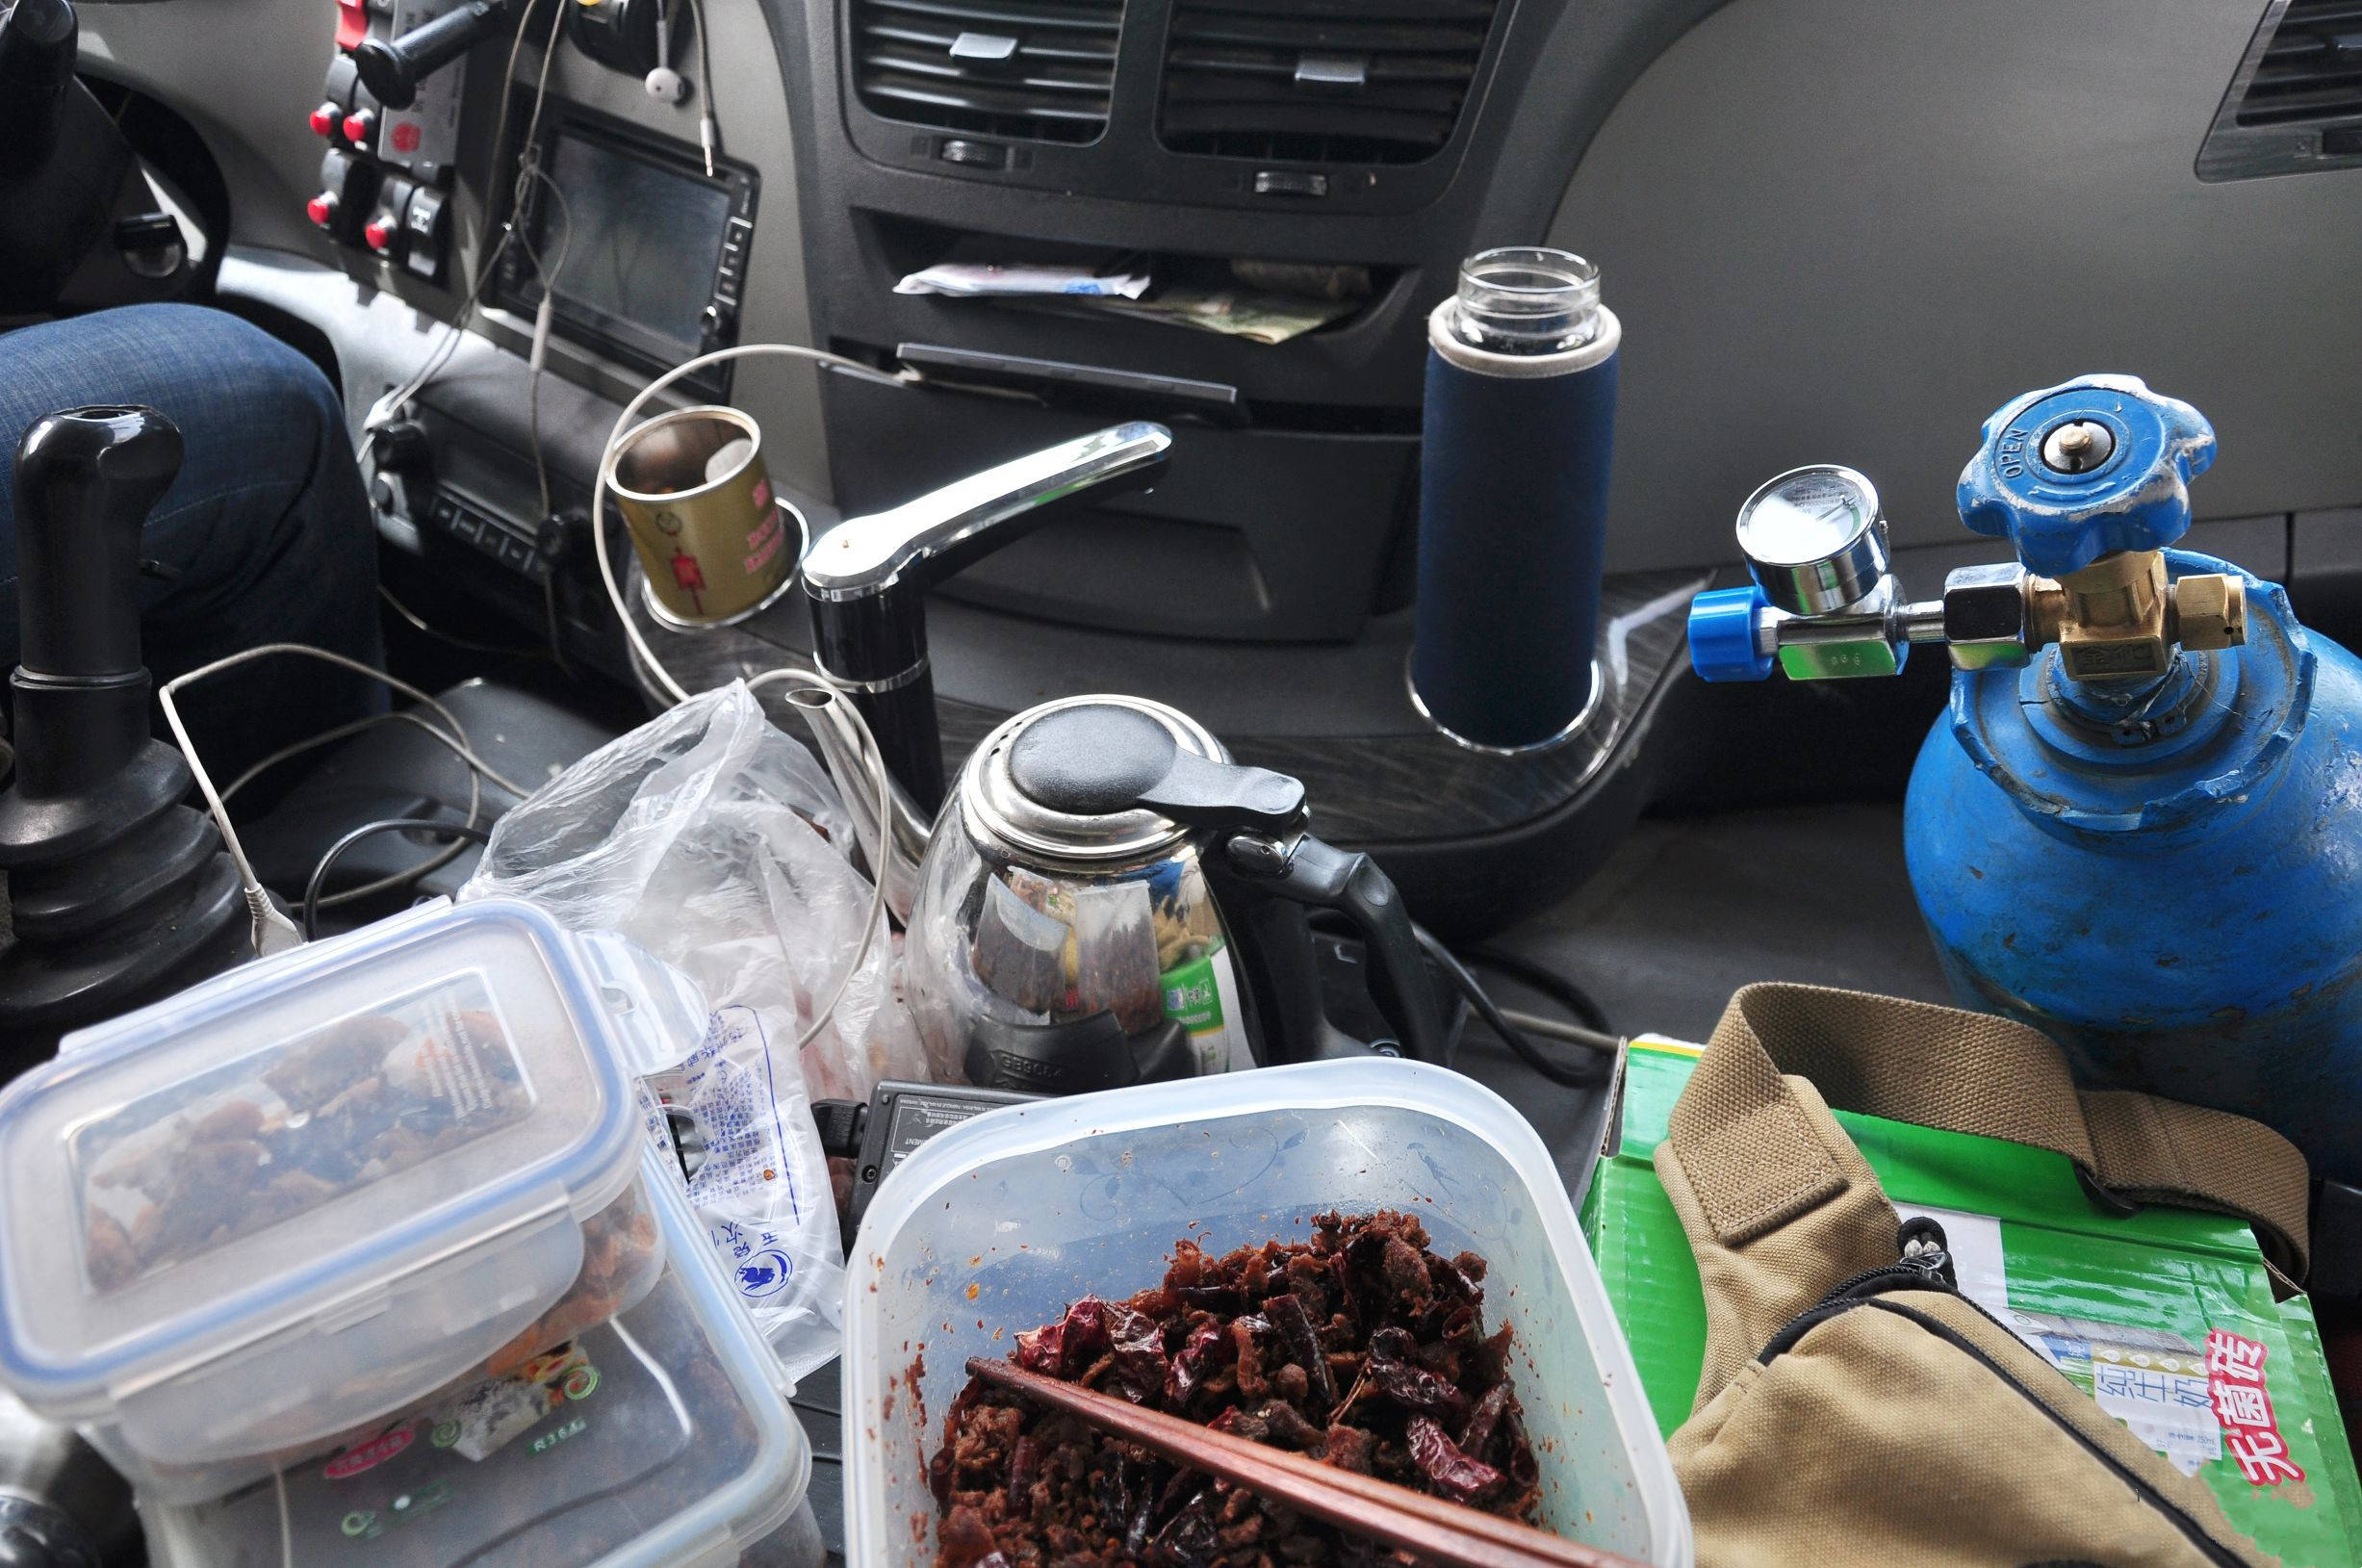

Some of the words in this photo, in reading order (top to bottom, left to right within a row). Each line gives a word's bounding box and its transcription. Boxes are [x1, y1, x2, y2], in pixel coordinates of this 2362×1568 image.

[2000, 429, 2028, 478] OPEN
[905, 1137, 925, 1146] MENT
[2096, 1365, 2214, 1409] 纯牛奶
[2210, 1332, 2300, 1482] 无菌砖
